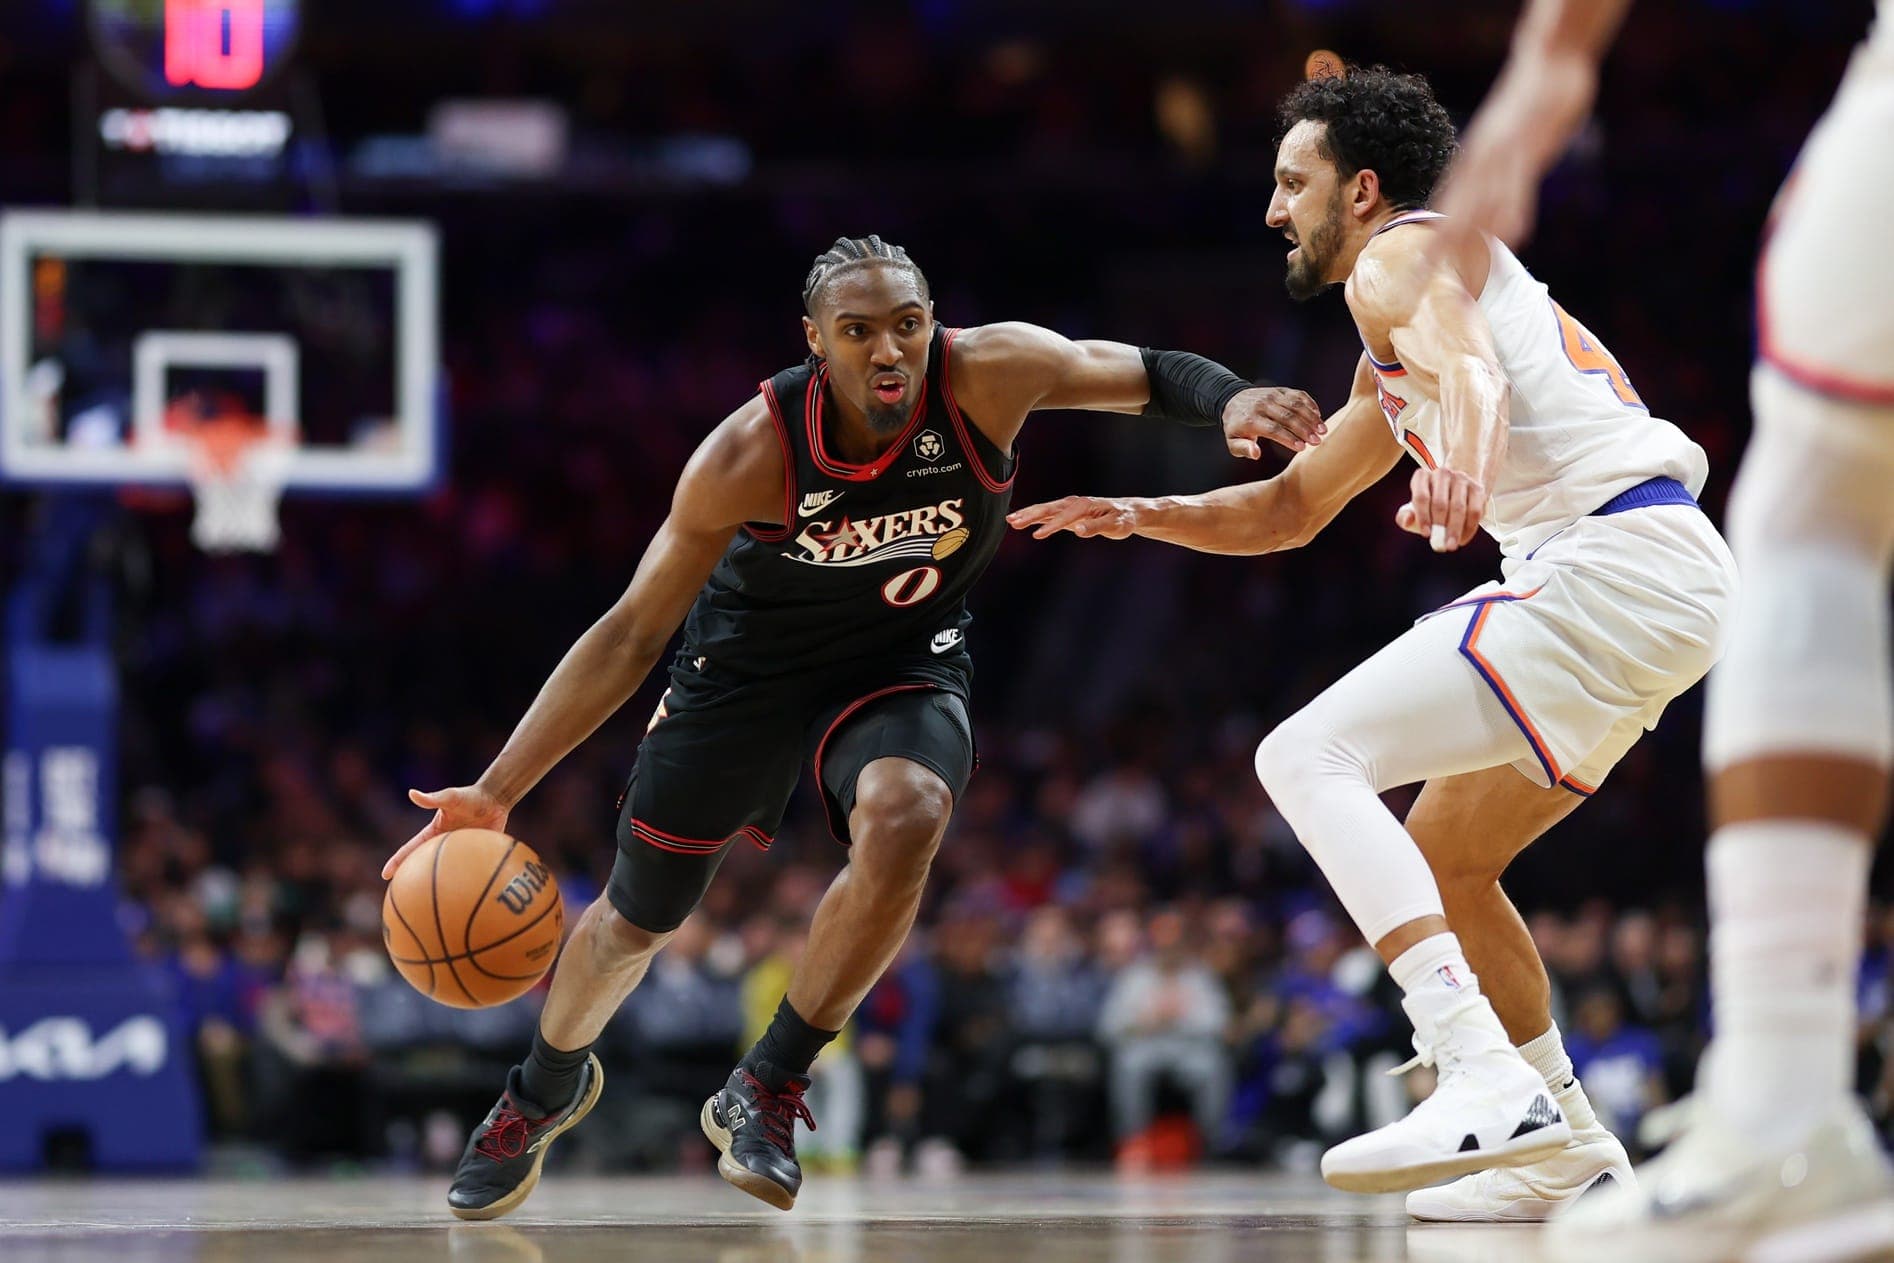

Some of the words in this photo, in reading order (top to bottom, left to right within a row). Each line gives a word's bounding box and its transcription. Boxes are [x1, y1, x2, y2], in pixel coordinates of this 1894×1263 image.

[906, 462, 962, 478] crypto.com
[803, 490, 834, 508] NIKE
[881, 566, 942, 608] 0
[934, 628, 959, 644] NIKE
